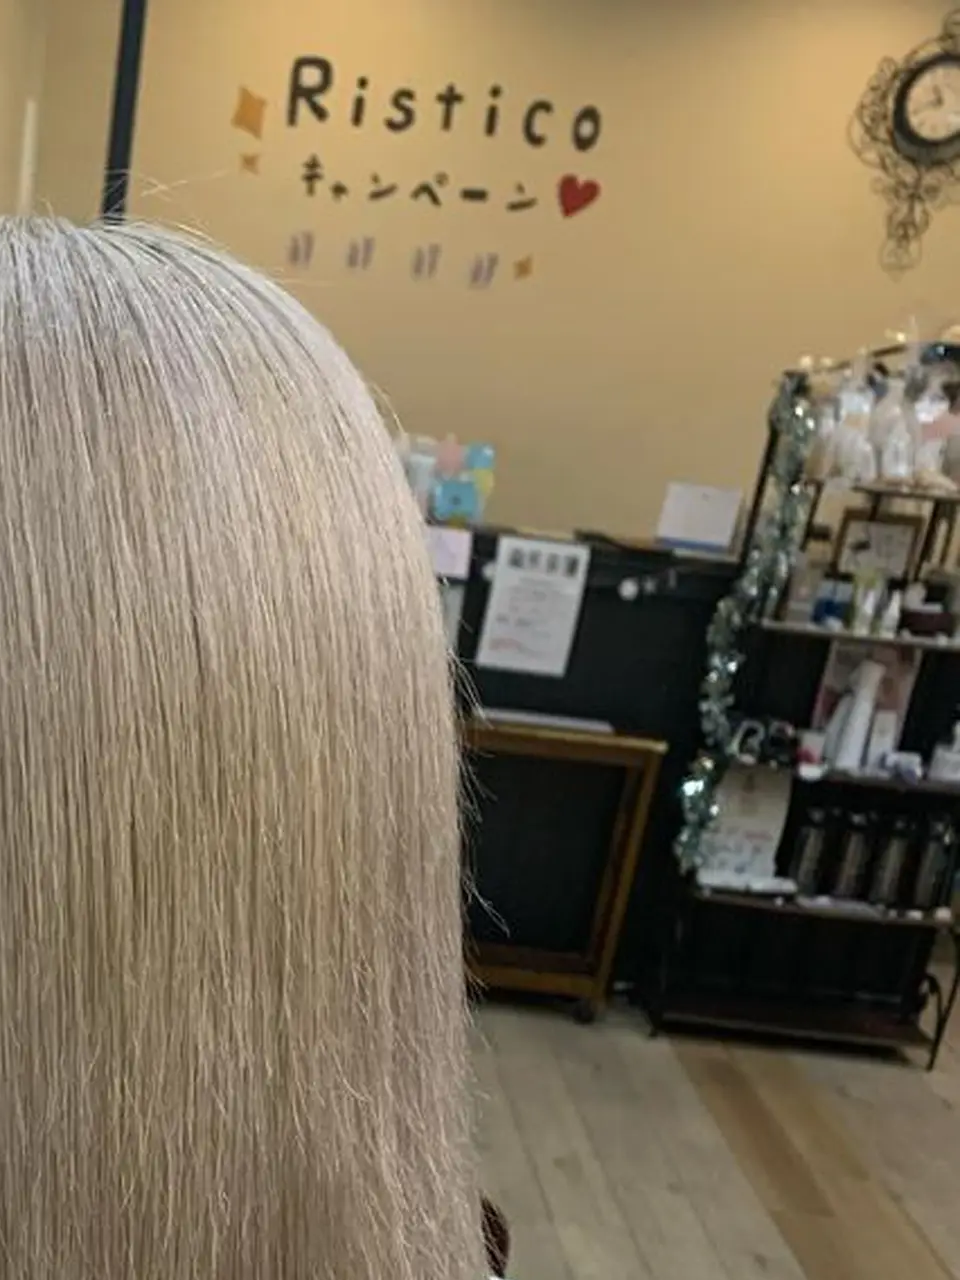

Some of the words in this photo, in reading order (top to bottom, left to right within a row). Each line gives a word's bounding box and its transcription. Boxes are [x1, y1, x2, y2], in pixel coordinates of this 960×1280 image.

[286, 55, 602, 152] Ristico
[301, 154, 537, 212] キャンペーン
